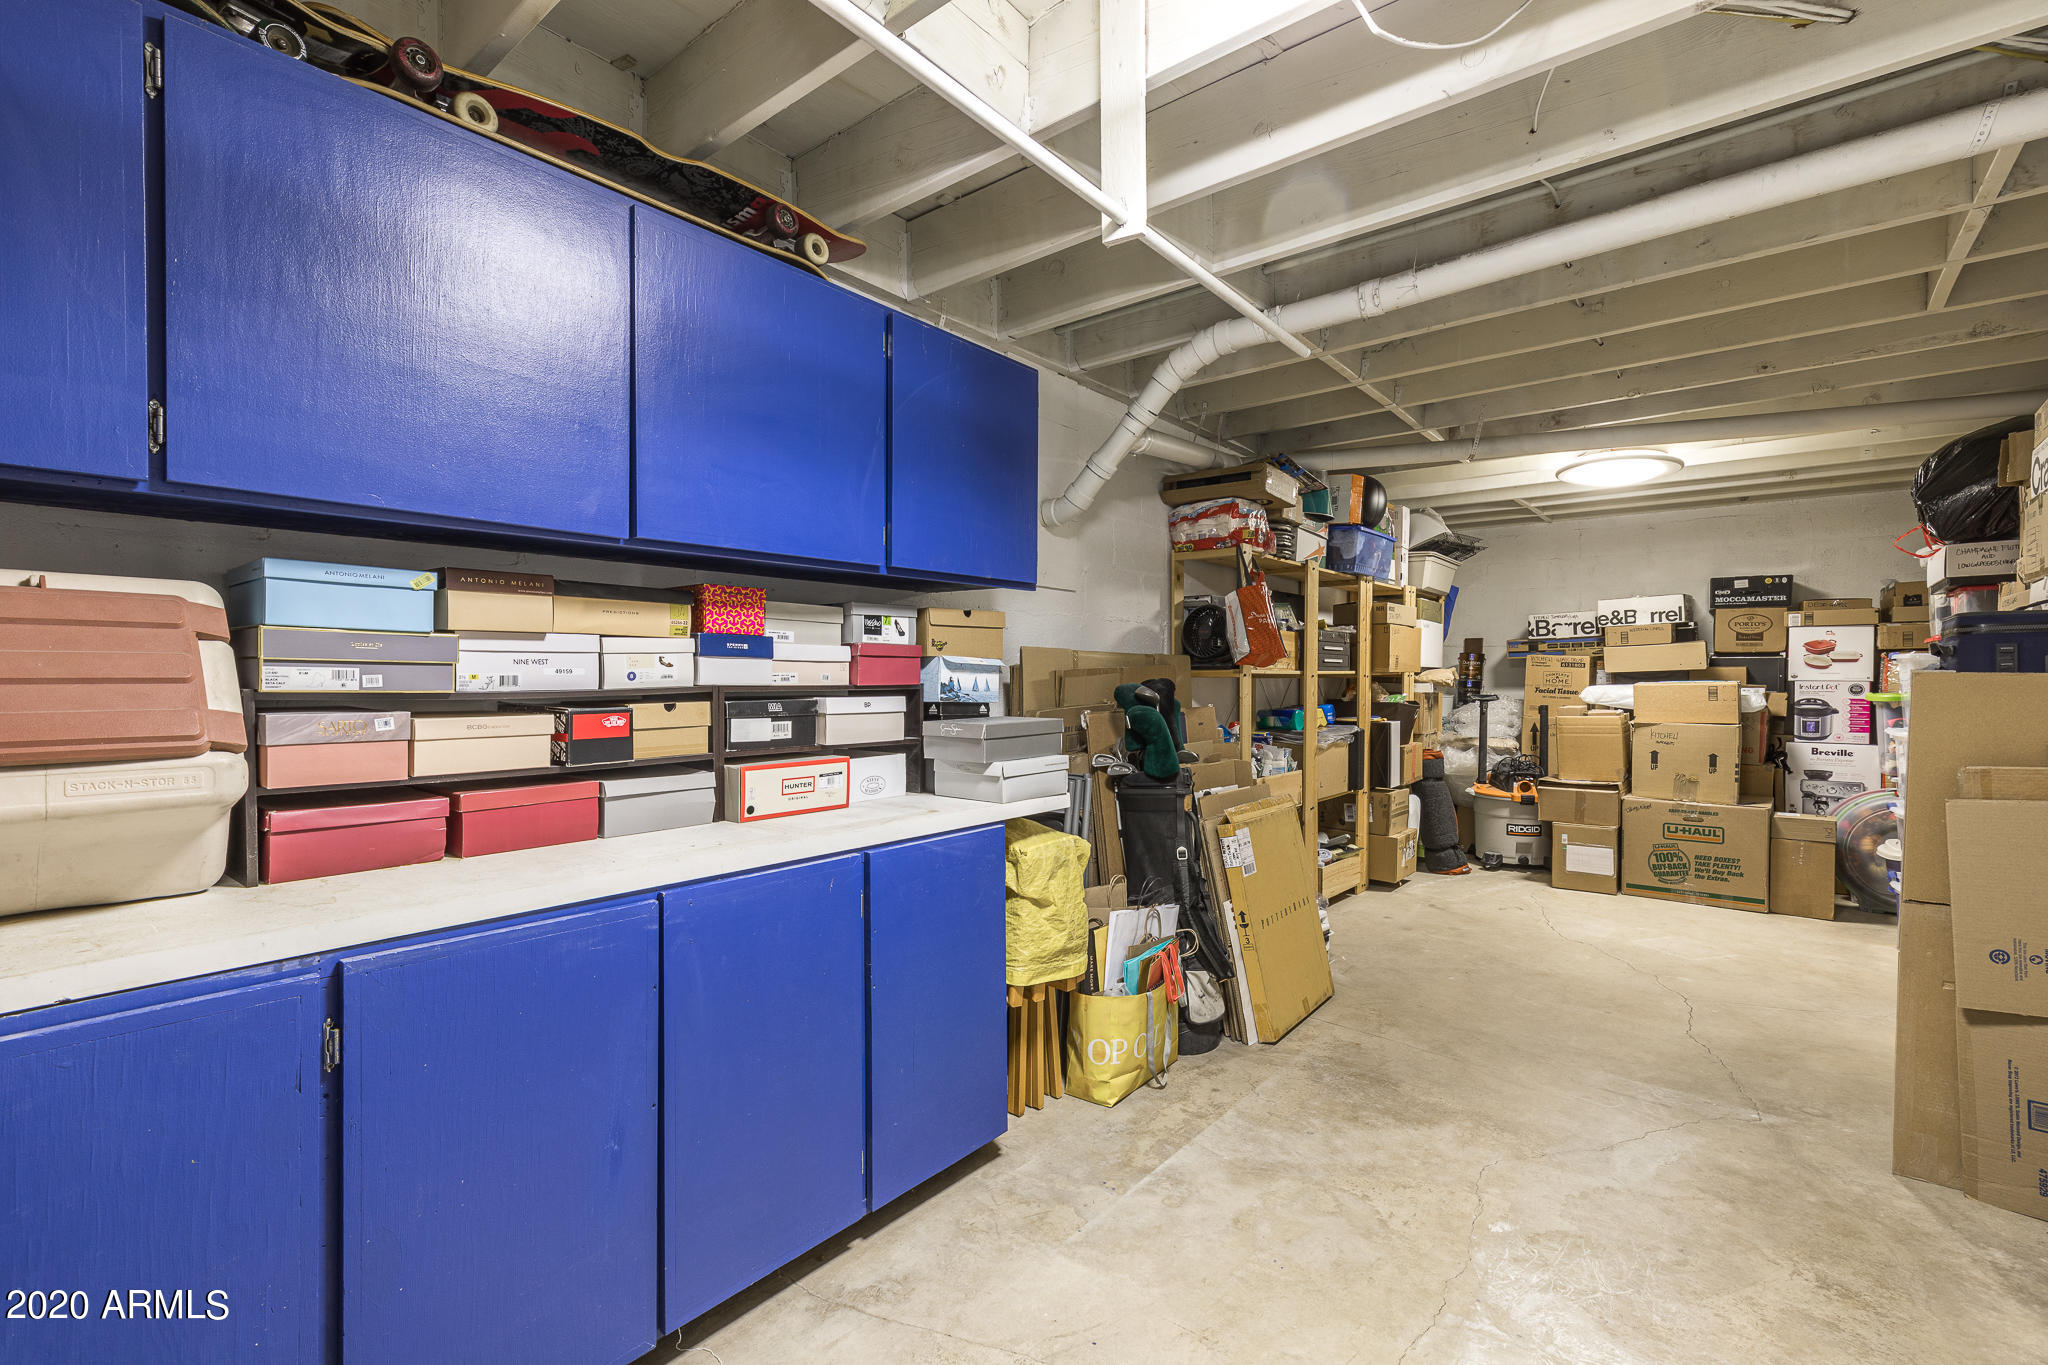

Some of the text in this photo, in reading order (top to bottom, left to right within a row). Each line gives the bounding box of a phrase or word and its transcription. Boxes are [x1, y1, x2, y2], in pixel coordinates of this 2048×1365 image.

[324, 570, 358, 578] ANTONIO
[460, 576, 544, 588] ANTONIO MELANI
[1715, 595, 1787, 603] MOCCAMASTER
[1598, 605, 1683, 626] e&Brrel
[513, 658, 549, 666] NINE WEST
[1535, 686, 1580, 696] Facial Tissue
[317, 719, 368, 734] SARTO
[1811, 747, 1854, 757] Breville
[1709, 767, 1718, 775] UP
[70, 777, 176, 792] STACK-N-STOR
[784, 781, 813, 790] HUNTER
[1507, 825, 1541, 833] RIDGID
[1666, 825, 1721, 838] U-HAUL
[1653, 851, 1684, 863] 100%
[1713, 856, 1741, 864] BOXES?
[1651, 862, 1688, 871] BUY-BACK
[1712, 862, 1742, 871] PLENTY!
[1653, 870, 1690, 878] GUARANTEE
[1712, 869, 1725, 877] Buy
[1245, 937, 1251, 945] 3
[1087, 1038, 1128, 1066] OP
